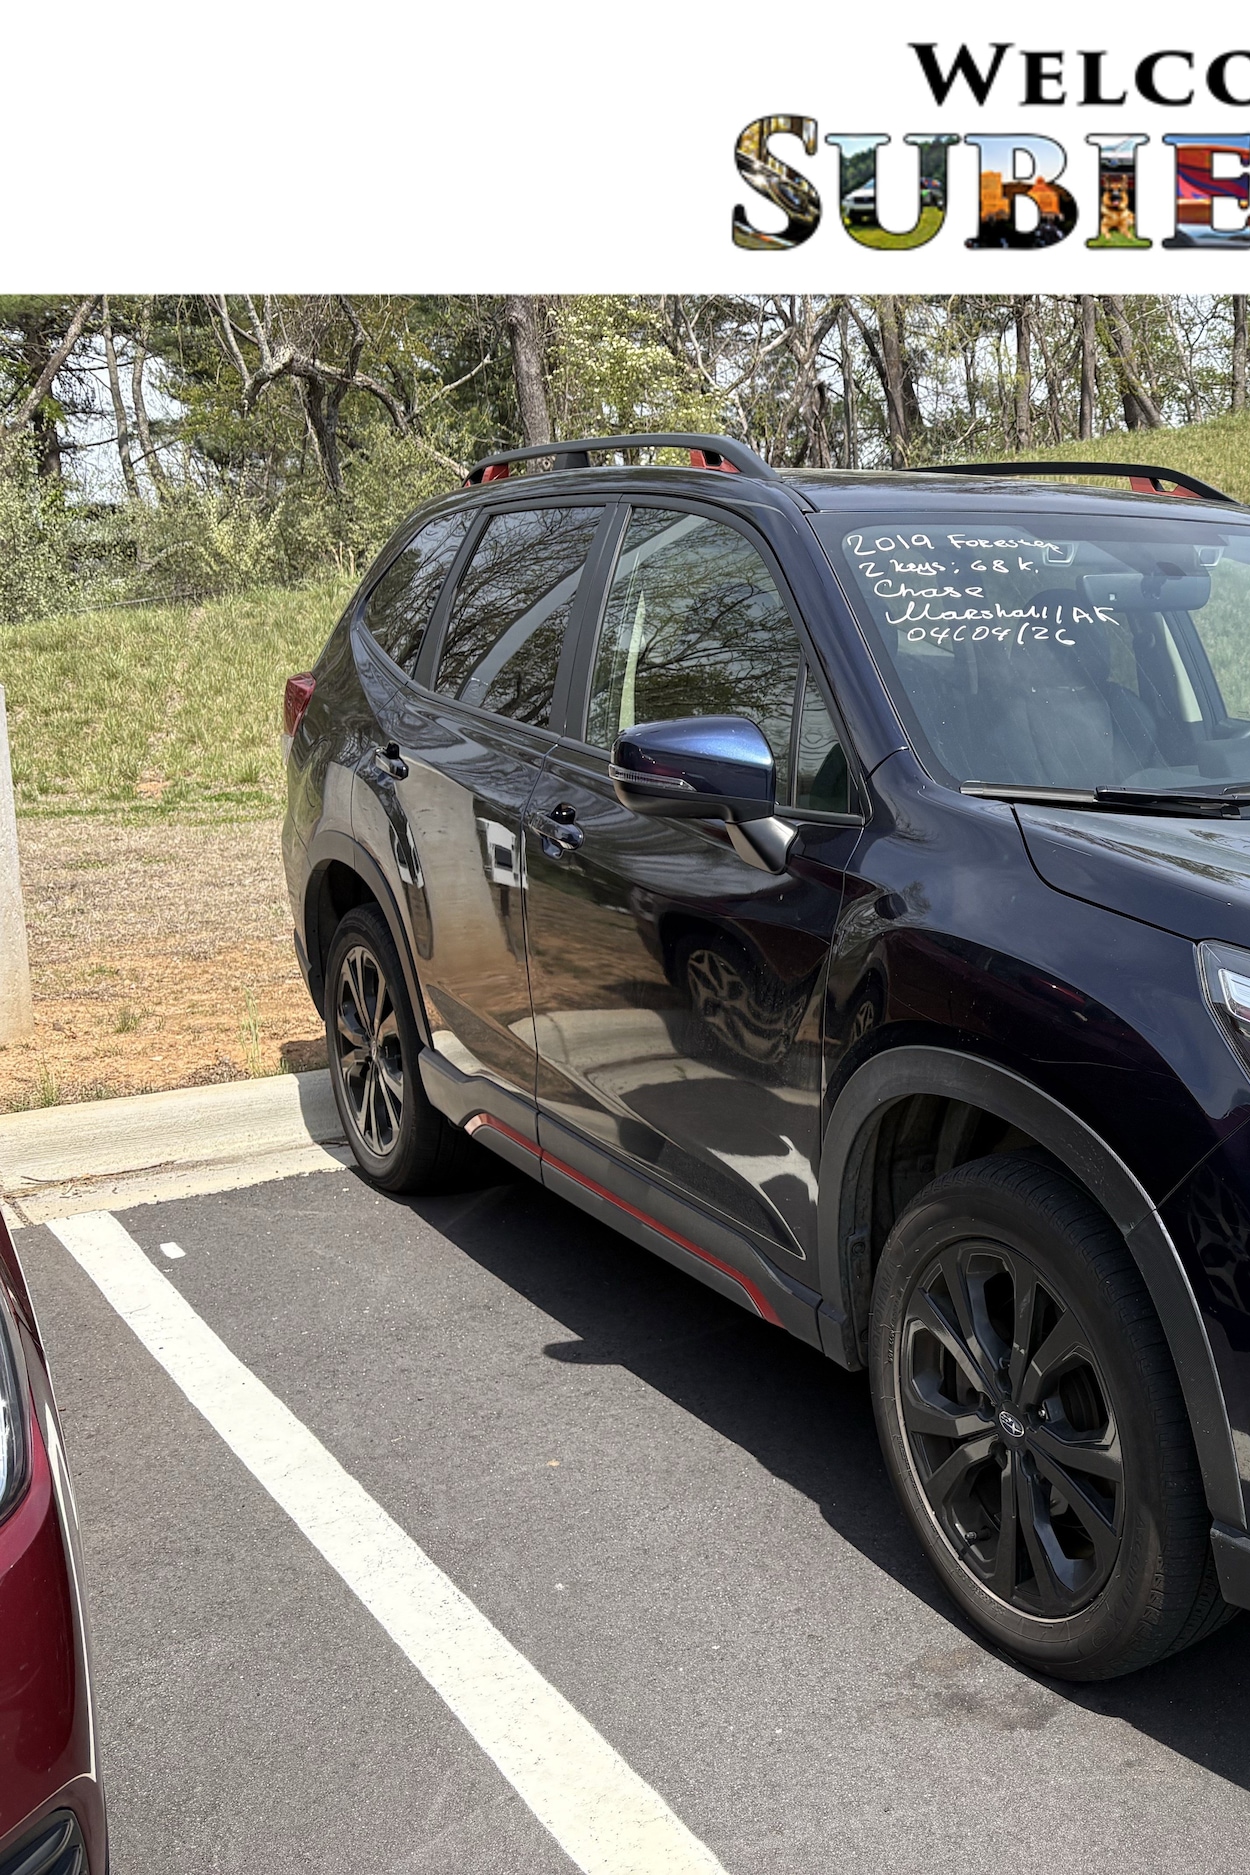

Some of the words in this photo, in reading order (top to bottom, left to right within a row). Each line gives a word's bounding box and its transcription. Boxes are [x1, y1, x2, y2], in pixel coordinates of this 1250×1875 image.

[846, 533, 935, 556] 2019
[858, 562, 884, 578] 2
[873, 579, 985, 599] Chase
